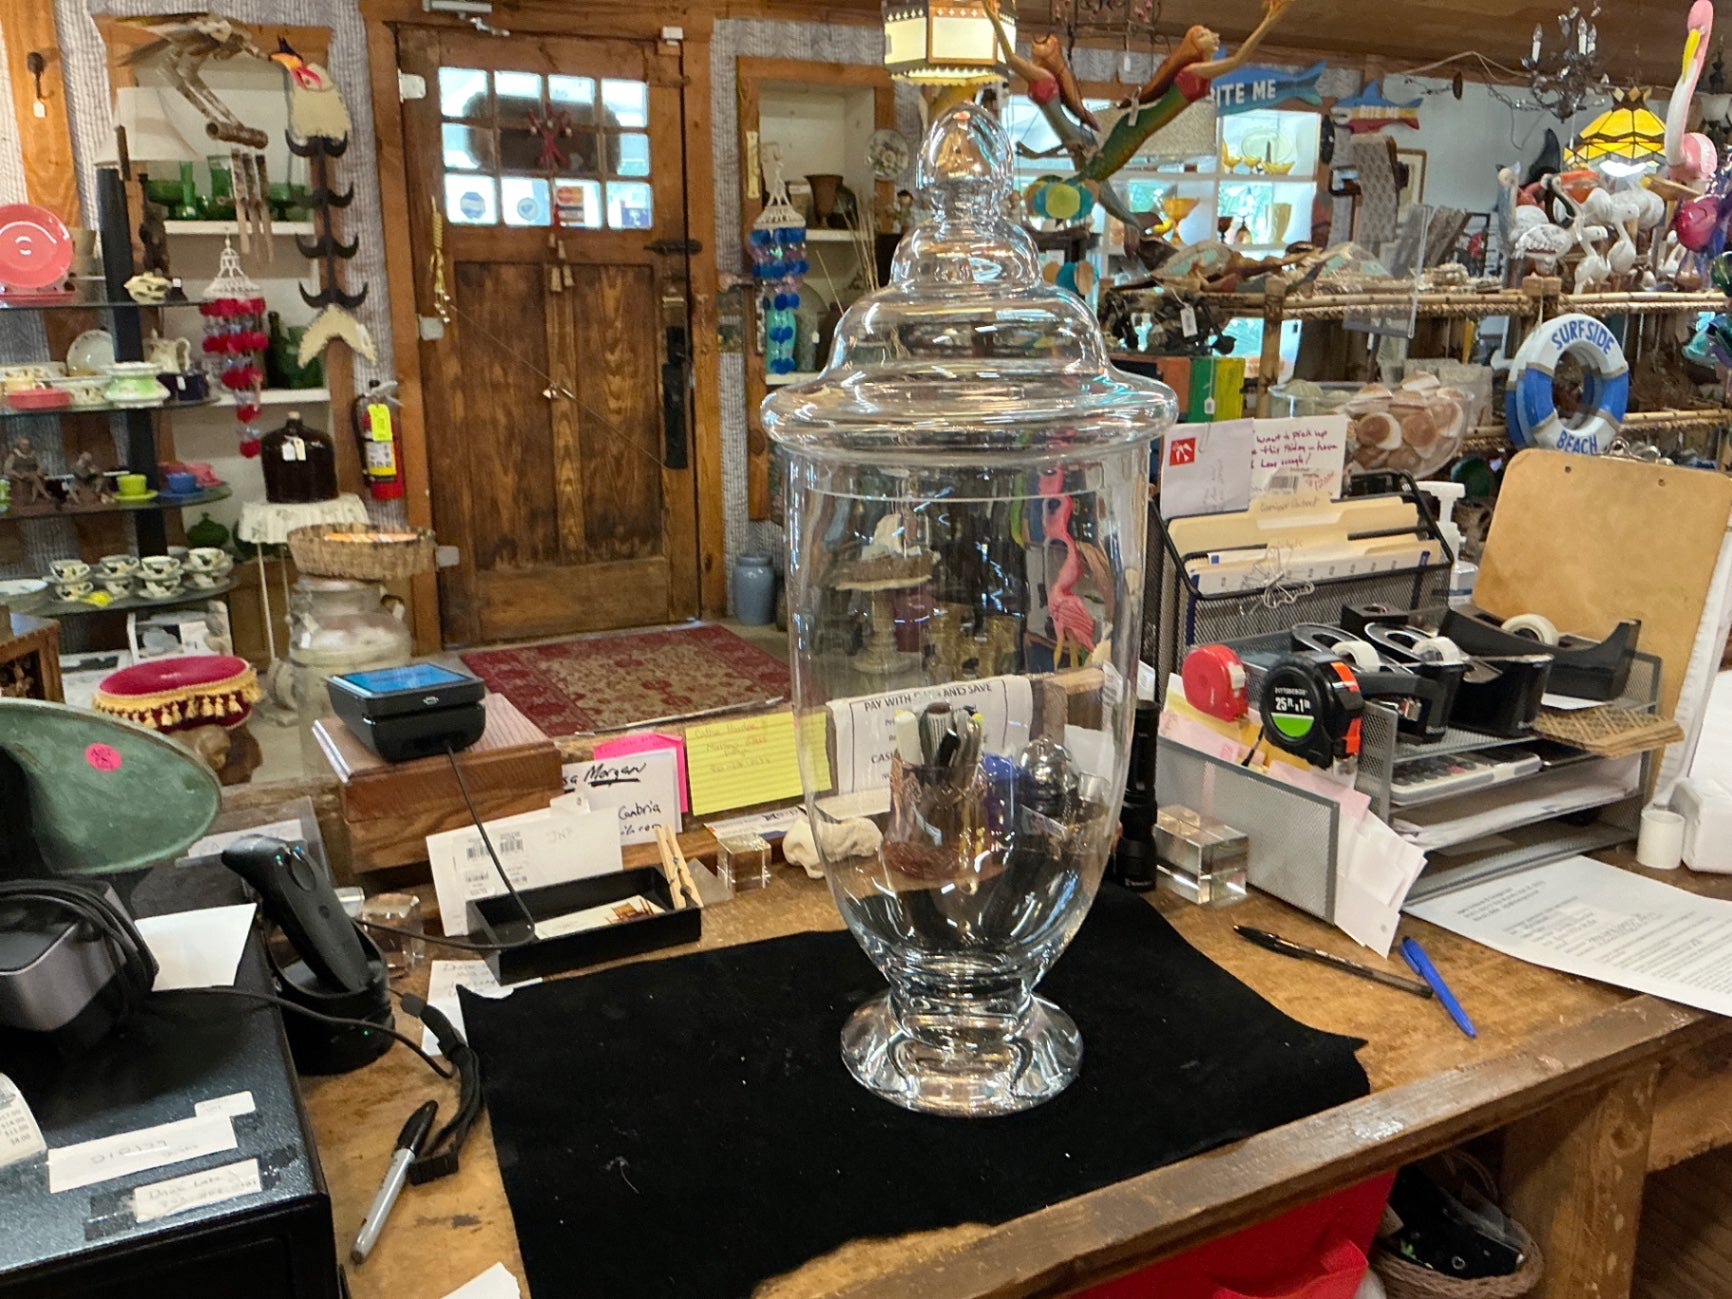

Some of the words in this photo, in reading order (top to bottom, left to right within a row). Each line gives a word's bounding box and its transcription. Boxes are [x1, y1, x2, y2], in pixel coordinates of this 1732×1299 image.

[1252, 79, 1276, 101] ME
[1359, 104, 1381, 118] BITE
[1385, 106, 1400, 118] ME
[1552, 320, 1615, 355] SURFSIDE
[1556, 430, 1598, 454] BEACH
[864, 699, 882, 712] PAY
[884, 693, 912, 707] WITH
[942, 685, 967, 698] AND
[967, 681, 993, 694] SAVE
[871, 751, 894, 764] CAS
[584, 762, 646, 783] Morgan
